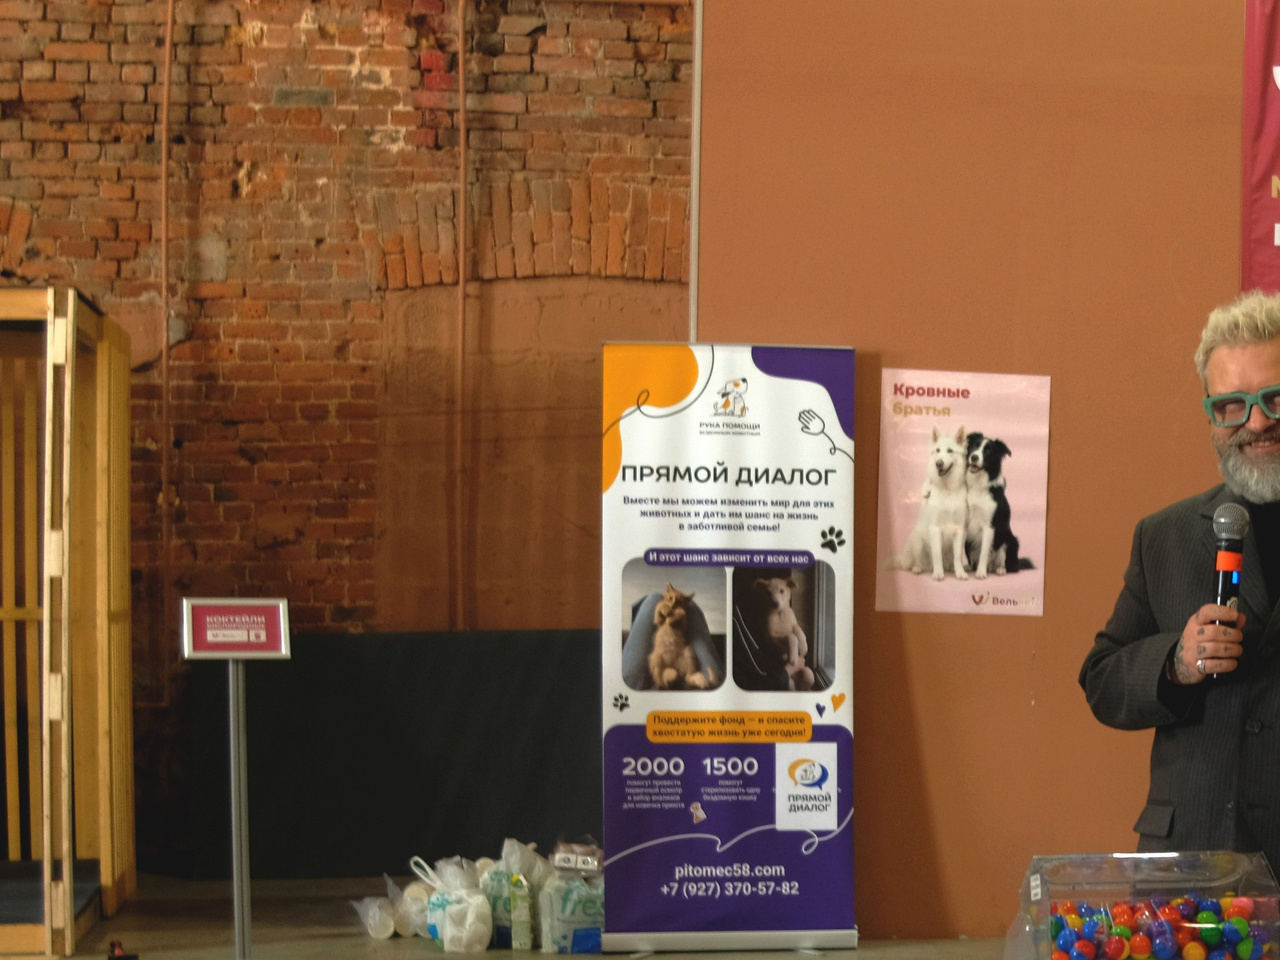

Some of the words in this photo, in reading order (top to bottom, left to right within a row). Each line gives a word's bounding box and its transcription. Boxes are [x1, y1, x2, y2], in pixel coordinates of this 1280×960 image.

[893, 382, 971, 399] Кровные
[892, 401, 952, 418] братья
[699, 421, 721, 429] РУКА
[722, 421, 761, 430] ПОМОЩИ
[621, 460, 730, 484] ПРЯМОЙ
[735, 467, 837, 487] ДИАЛОГ
[623, 496, 660, 505] Вместе
[662, 498, 679, 506] мы
[681, 498, 718, 506] можем
[720, 498, 768, 507] изменить
[770, 499, 791, 510] мир
[792, 500, 811, 509] для
[813, 501, 836, 509] этих
[640, 509, 692, 518] животных
[702, 511, 727, 520] дать
[728, 511, 742, 519] им
[745, 512, 771, 520] шанс
[773, 512, 785, 520] на
[787, 512, 819, 521] жизнь
[678, 523, 685, 531] в
[687, 521, 745, 531] заботливой
[746, 523, 781, 532] семье!
[649, 551, 657, 561] И
[659, 553, 682, 562] этот
[683, 553, 710, 563] шанс
[711, 553, 751, 563] зависит
[753, 554, 766, 563] от
[767, 554, 790, 564] всех
[793, 555, 809, 564] нас
[652, 715, 717, 726] Поддержите
[719, 715, 746, 726] фонд
[766, 717, 806, 725] спасите
[652, 729, 705, 738] хвостатую
[708, 729, 740, 737] жизнь
[742, 729, 762, 738] уже
[764, 728, 806, 738] сегодня!
[622, 756, 685, 776] 2000
[702, 756, 759, 776] 1500
[787, 792, 832, 803] ПРЯМОЙ
[788, 803, 831, 813] ДИАЛОГ
[675, 863, 785, 881] pitomec58.com
[660, 881, 679, 896] +7
[682, 881, 721, 899] (927)
[724, 881, 800, 896] 370-57-82
